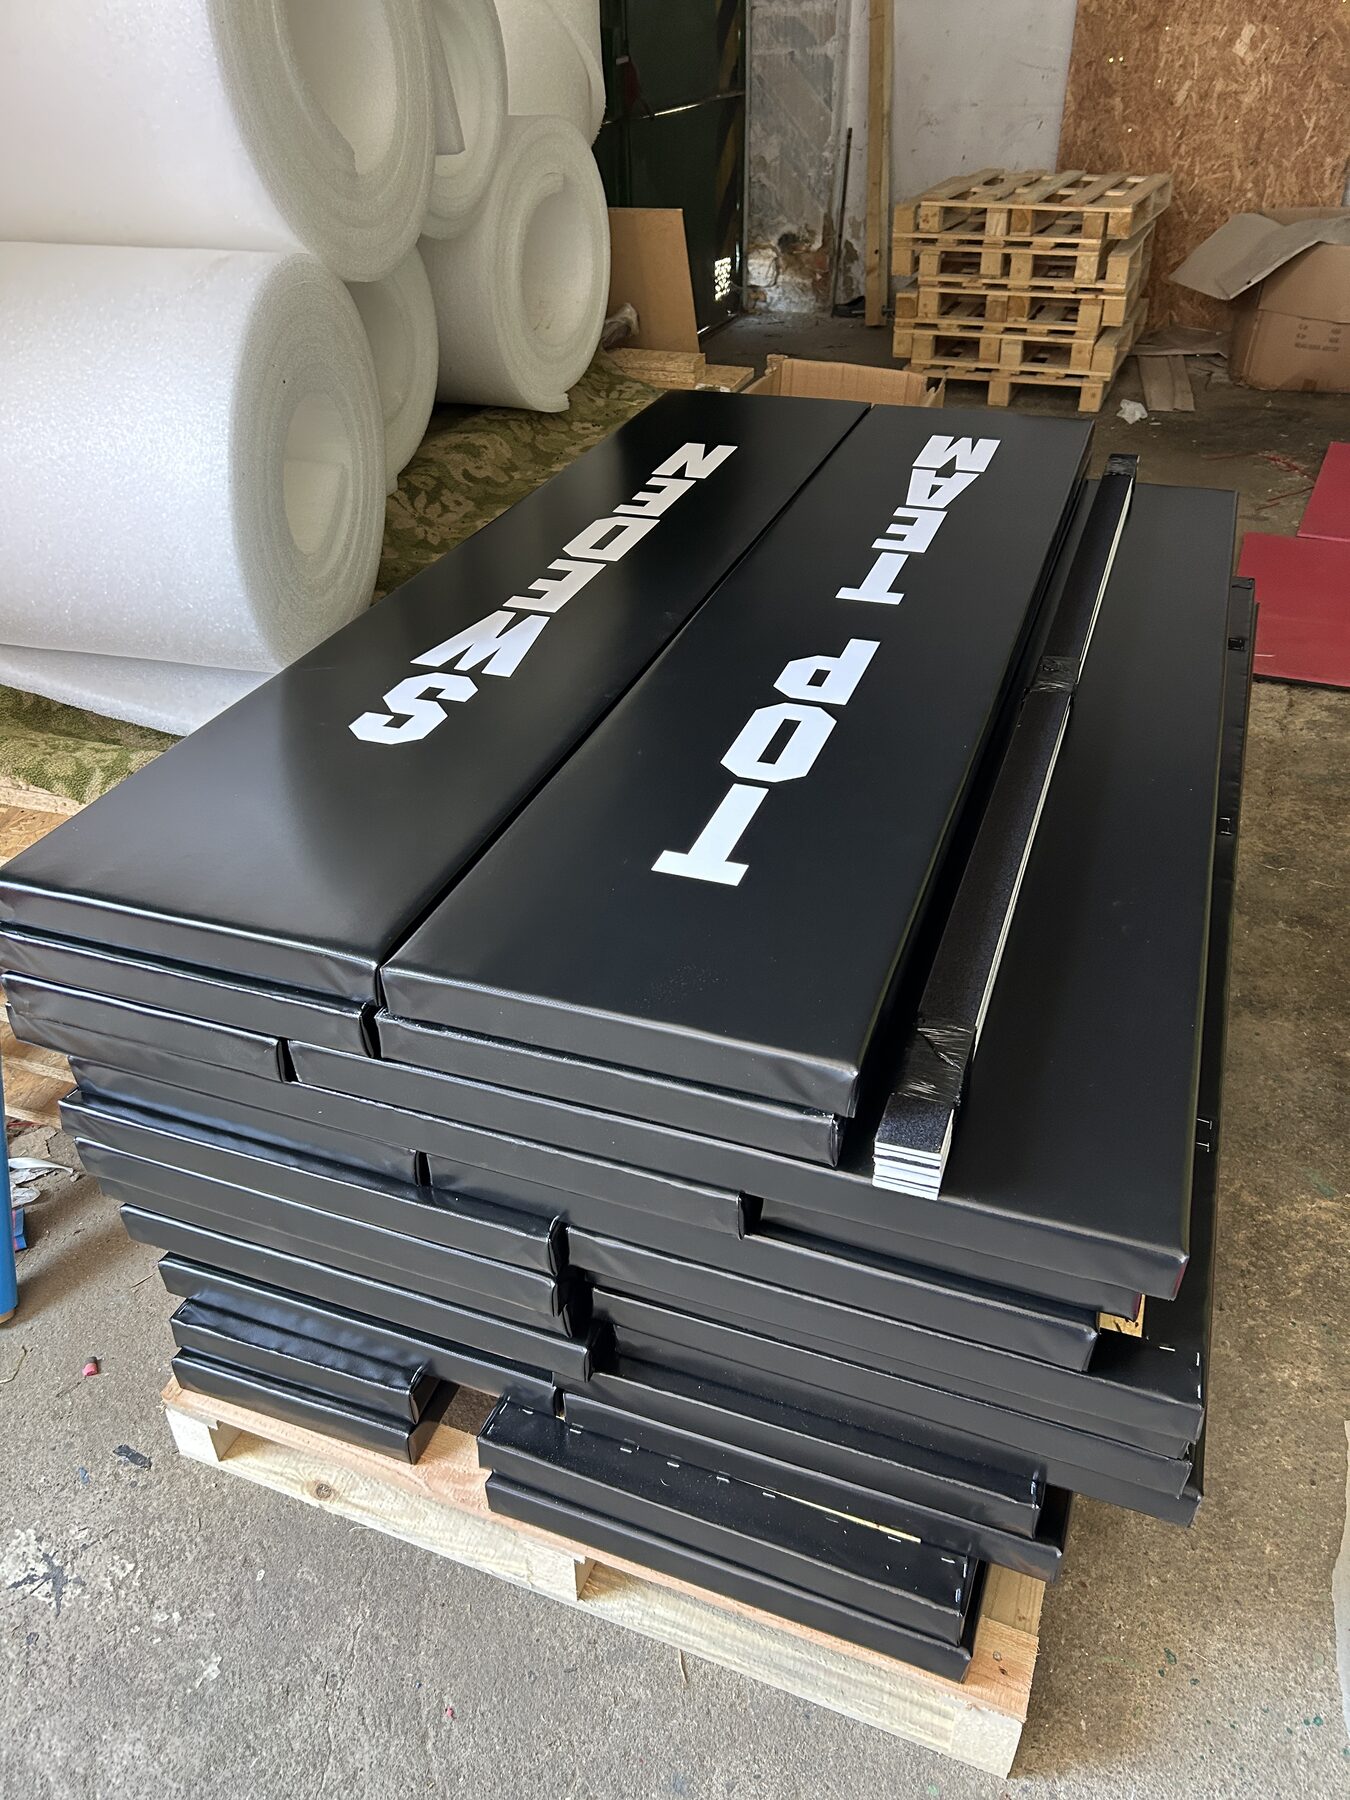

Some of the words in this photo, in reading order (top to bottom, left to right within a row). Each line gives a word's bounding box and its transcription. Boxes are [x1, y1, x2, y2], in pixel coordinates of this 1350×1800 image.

[348, 442, 737, 746] SWEDEN
[651, 639, 880, 887] TOP
[836, 435, 1001, 606] TEAM
